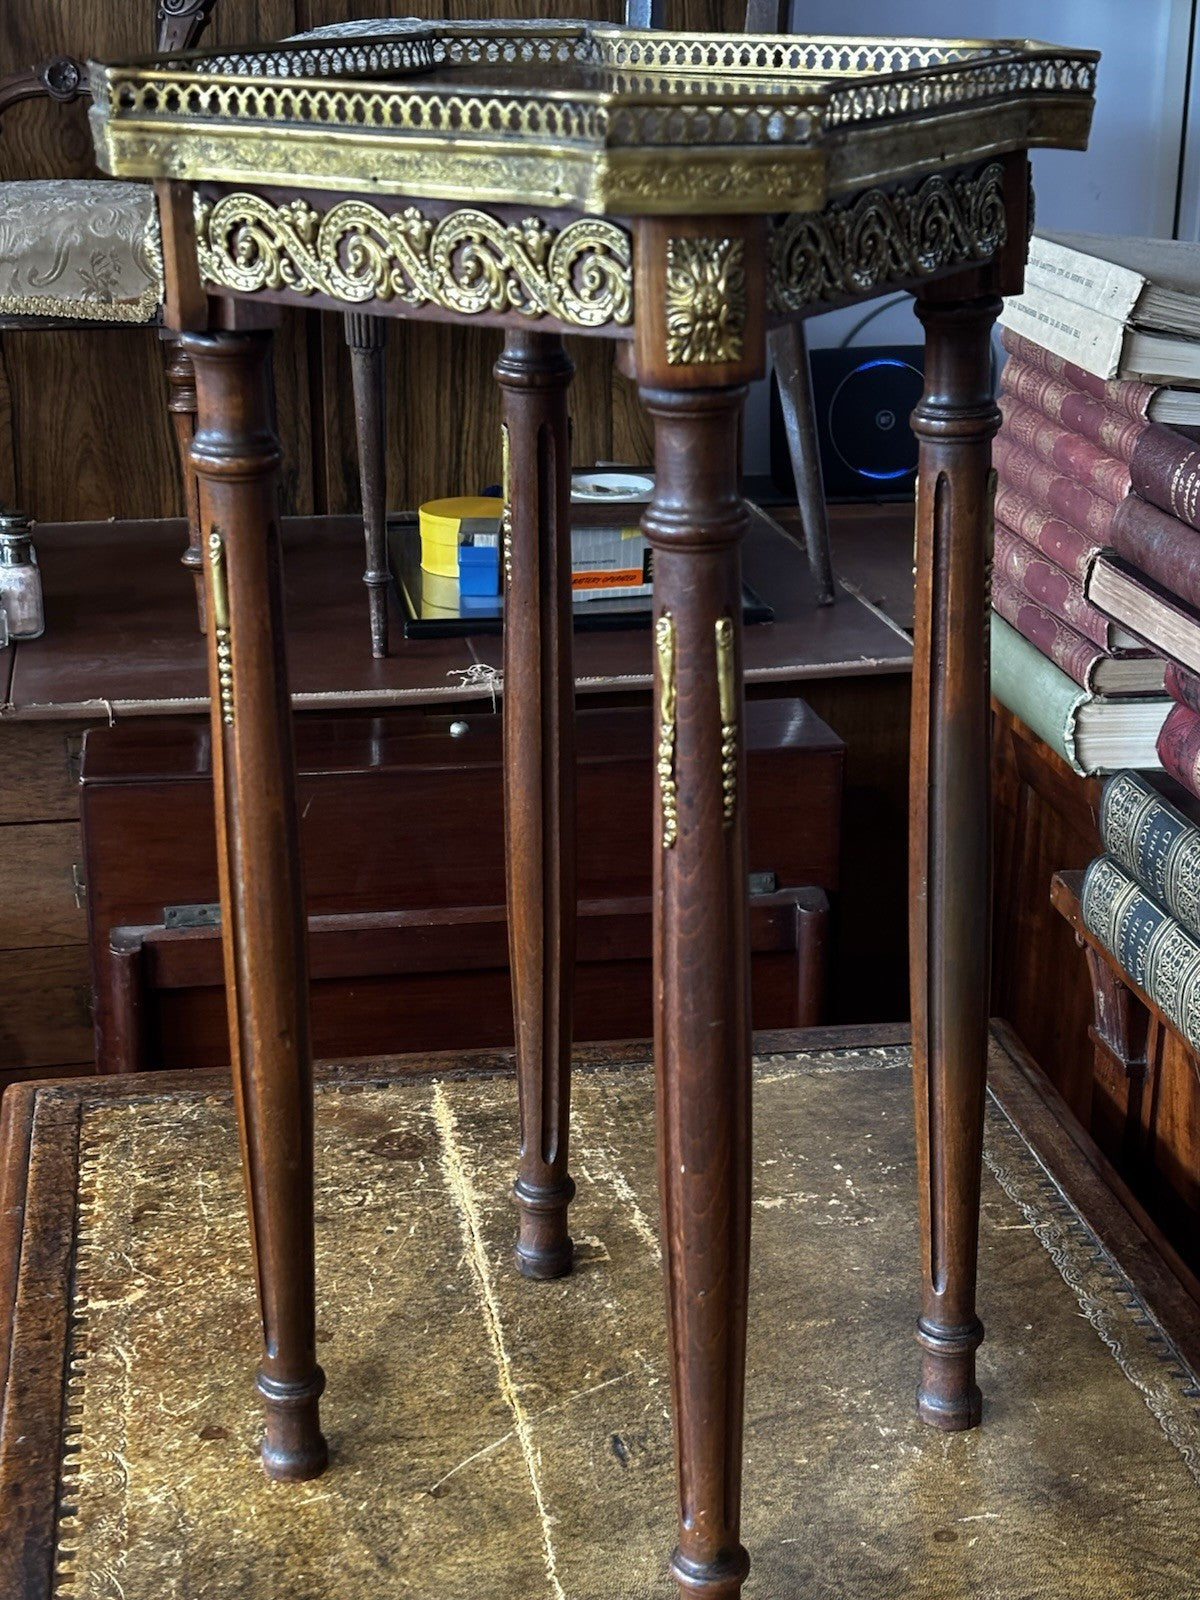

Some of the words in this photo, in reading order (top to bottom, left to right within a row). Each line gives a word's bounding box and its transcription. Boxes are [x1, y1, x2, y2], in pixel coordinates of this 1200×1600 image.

[1137, 806, 1161, 880] USTOMS
[1147, 829, 1160, 860] THE
[1128, 918, 1142, 946] THE
[1137, 920, 1154, 986] WORLD
